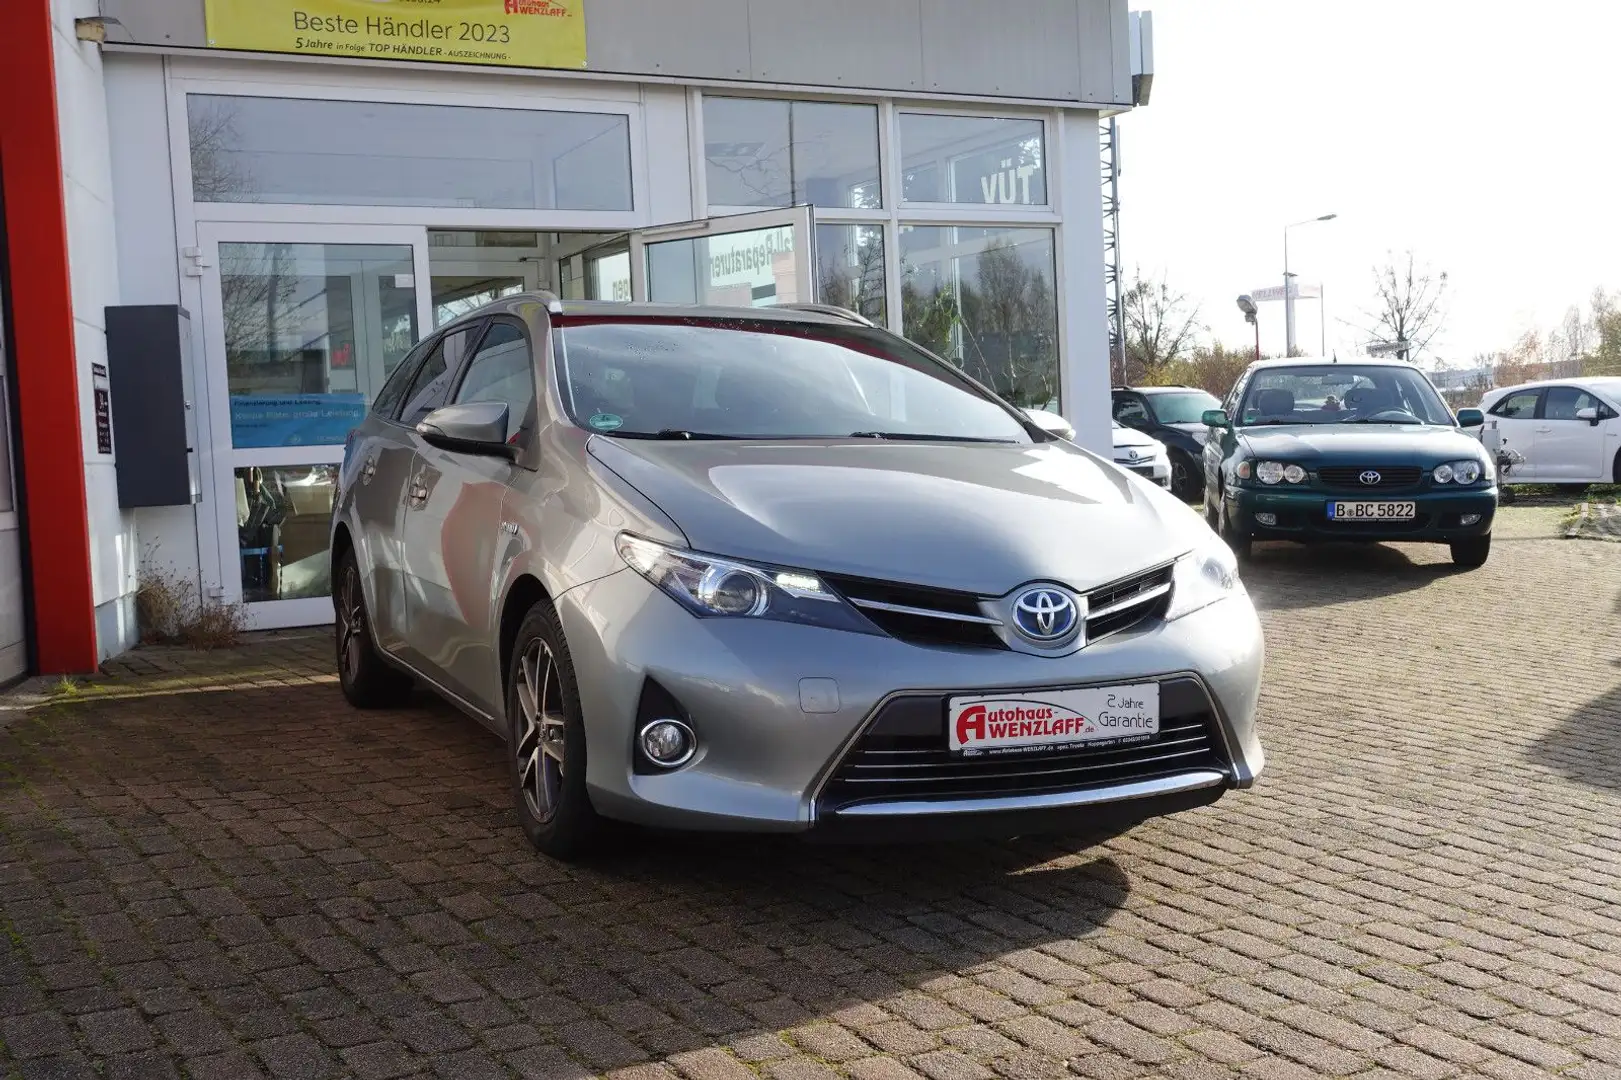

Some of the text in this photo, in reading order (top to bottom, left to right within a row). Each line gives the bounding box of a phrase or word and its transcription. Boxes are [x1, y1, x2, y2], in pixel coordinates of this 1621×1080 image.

[294, 11, 511, 43] Beste Händler 2023
[295, 37, 304, 49] 5
[305, 39, 333, 50] Jahre
[345, 43, 366, 53] Folge
[369, 43, 391, 53] TOP
[392, 44, 442, 56] HÄNDLER
[1336, 503, 1414, 517] B BC 5822
[1107, 693, 1144, 710] 2 Jahre
[1098, 711, 1154, 729] Garantie
